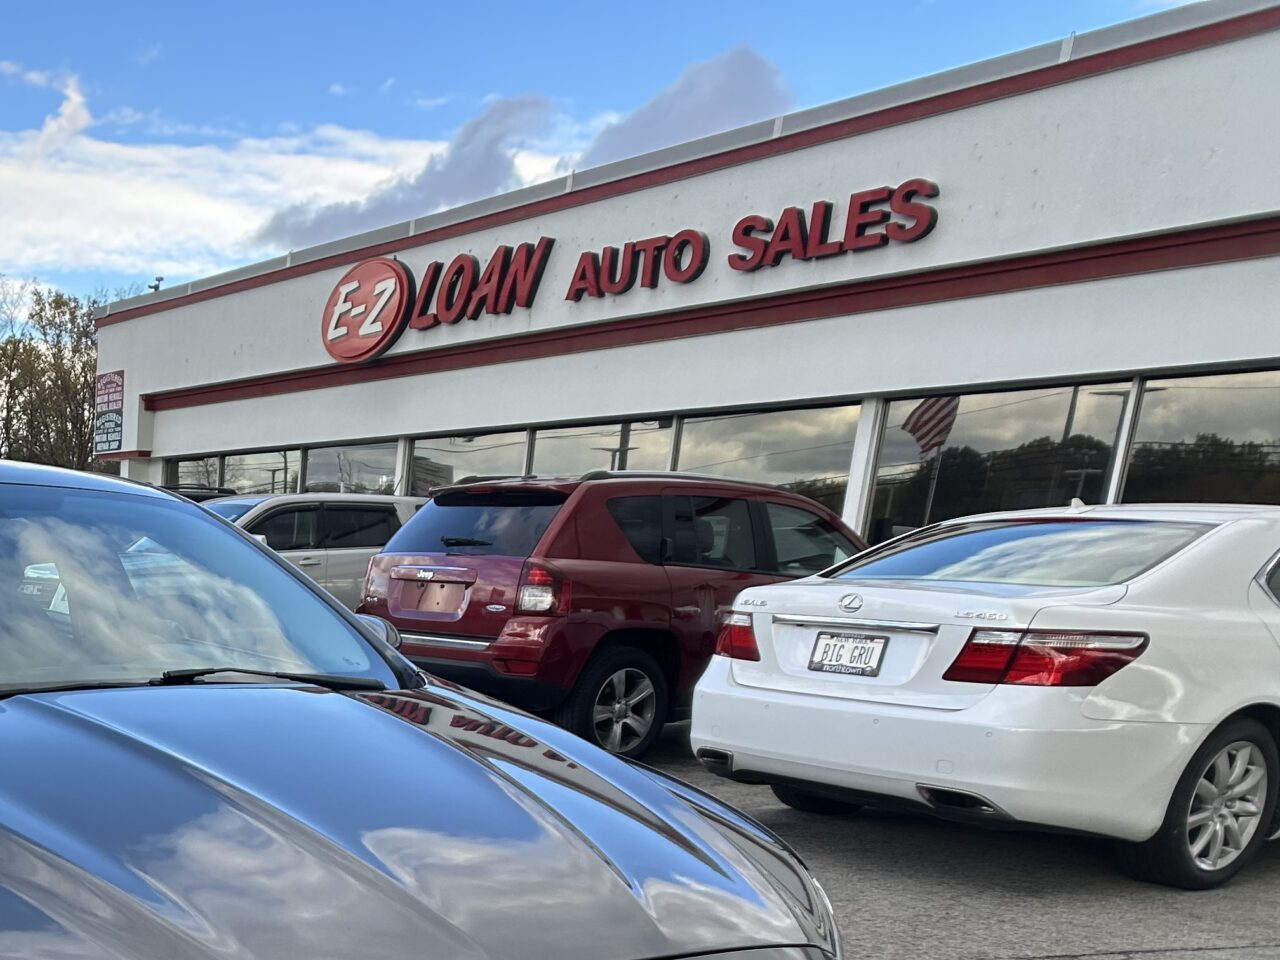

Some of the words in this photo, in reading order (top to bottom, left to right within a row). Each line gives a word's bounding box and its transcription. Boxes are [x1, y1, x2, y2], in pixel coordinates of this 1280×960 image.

[327, 276, 399, 341] E-Z
[409, 236, 554, 331] LOAN
[566, 229, 711, 301] AUTO
[727, 178, 941, 272] SALES
[821, 643, 845, 663] BIG
[849, 645, 875, 666] GRU
